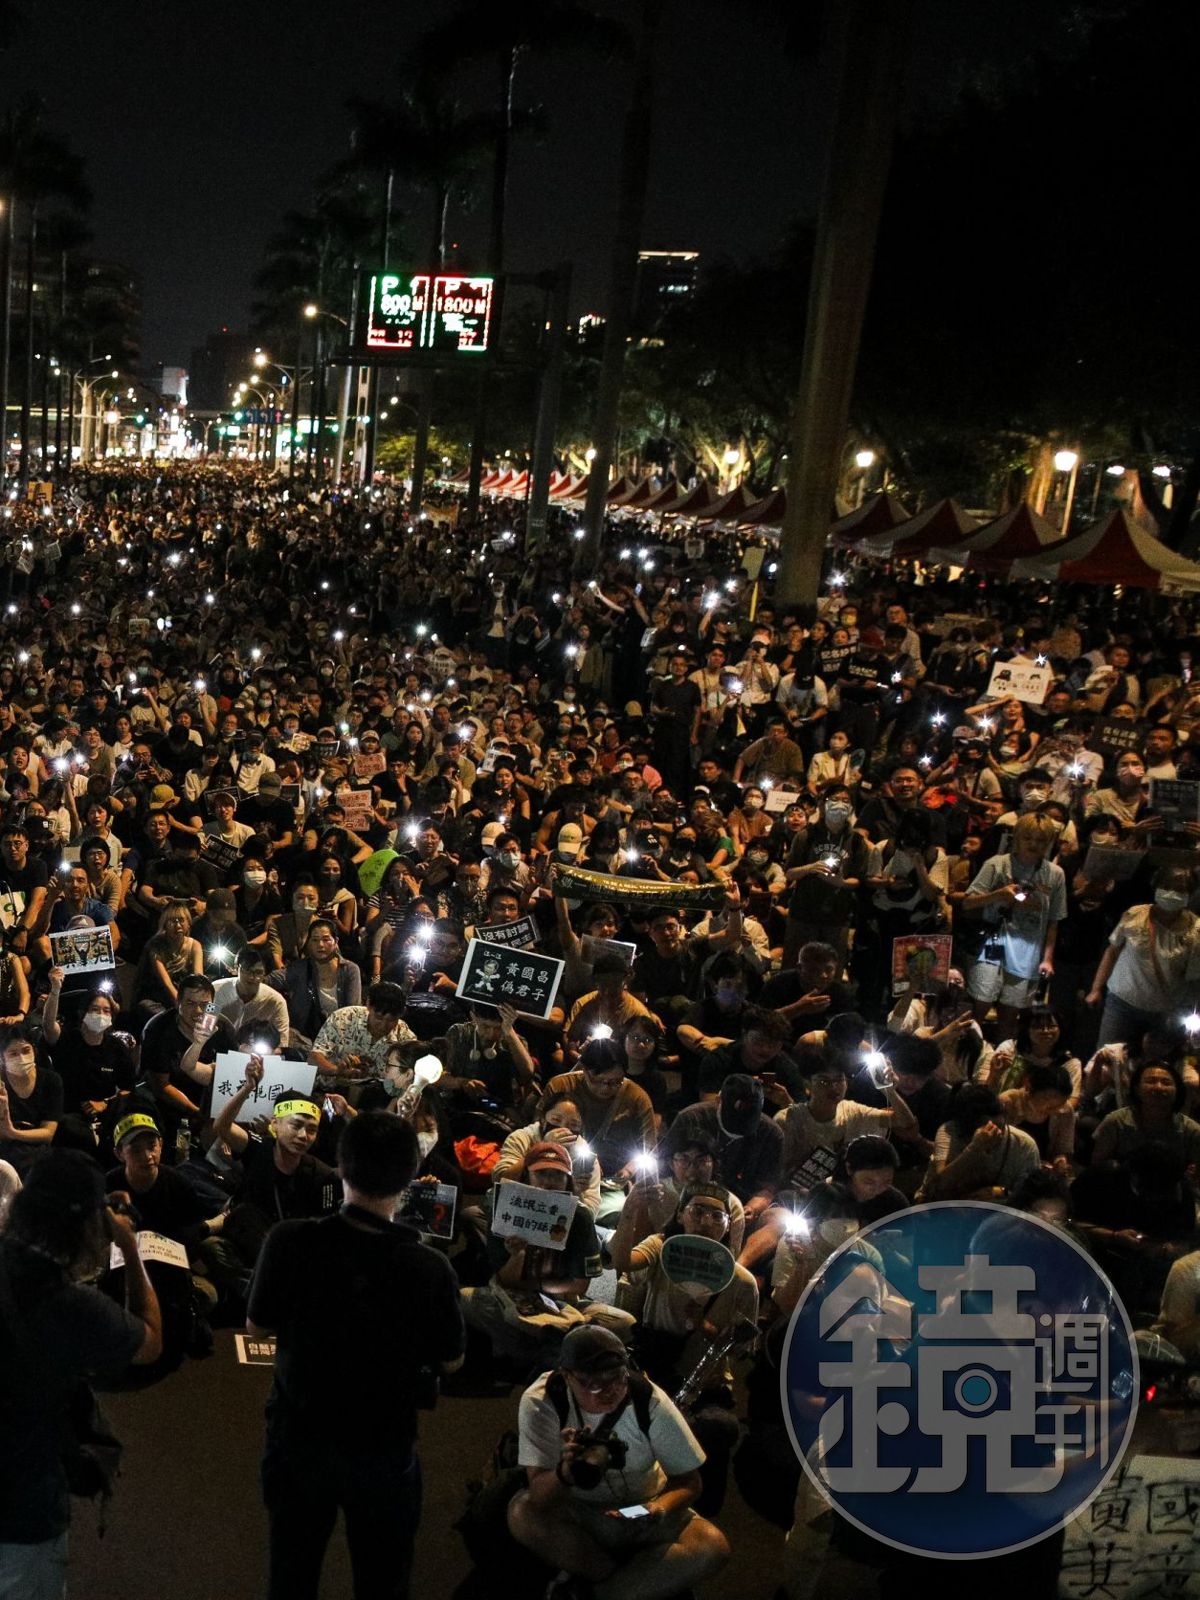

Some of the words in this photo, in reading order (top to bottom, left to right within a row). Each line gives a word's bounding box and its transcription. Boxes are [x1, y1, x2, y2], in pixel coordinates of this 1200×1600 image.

[482, 922, 529, 941] 沒有討論
[506, 962, 549, 984] 黃國昌
[501, 980, 545, 1001] 偽君子
